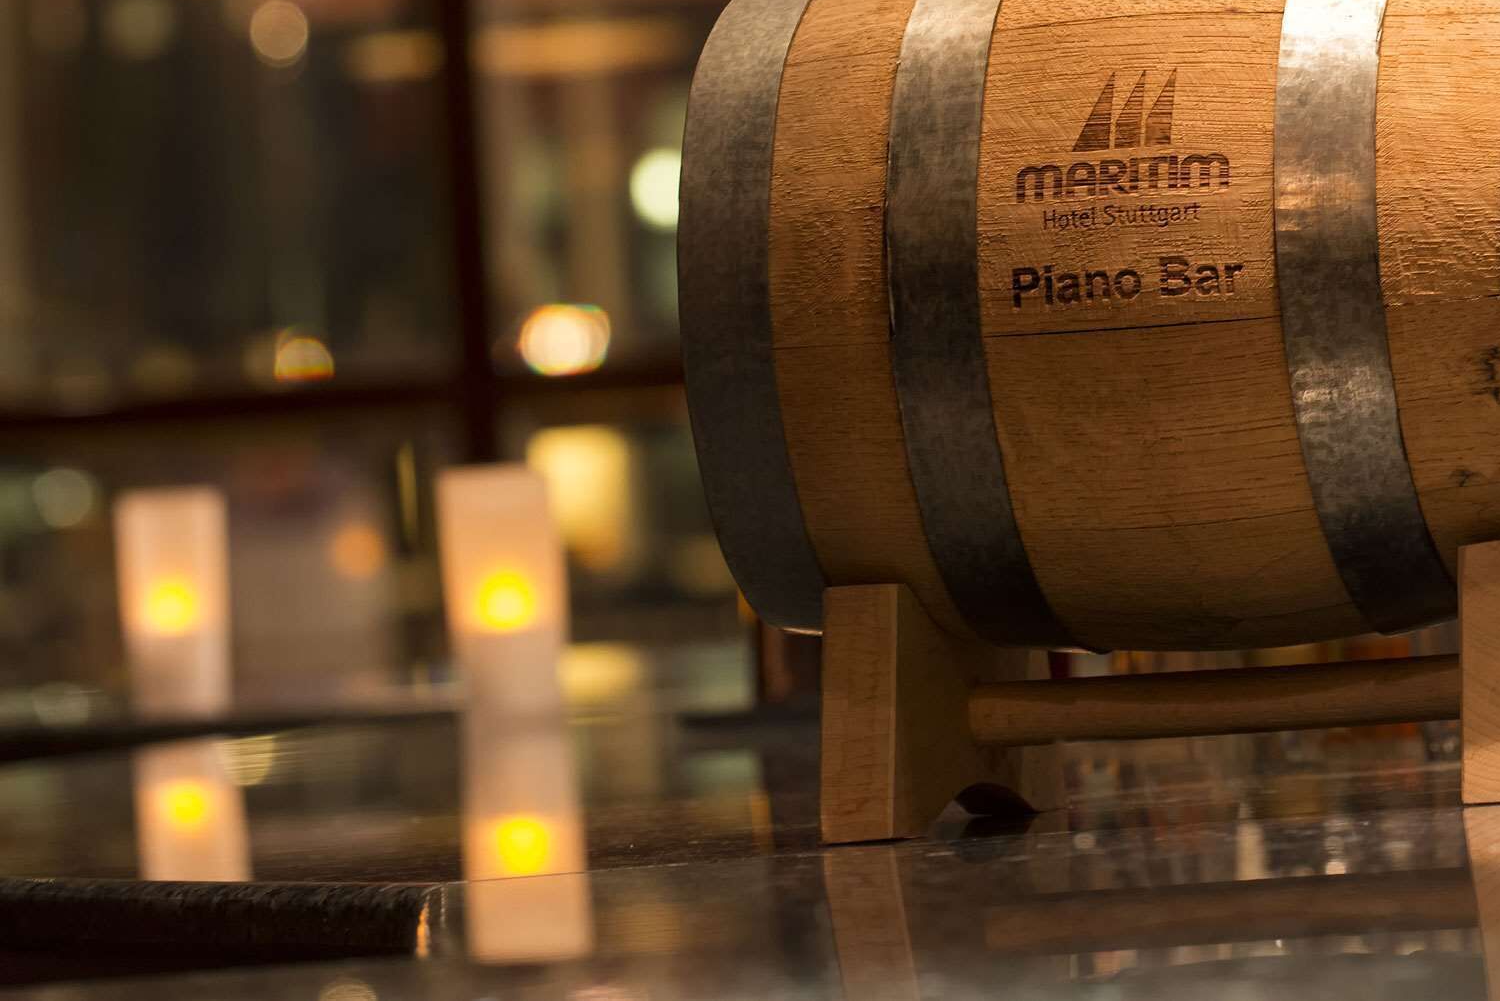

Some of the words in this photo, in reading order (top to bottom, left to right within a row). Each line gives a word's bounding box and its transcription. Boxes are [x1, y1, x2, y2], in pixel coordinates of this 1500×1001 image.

[1016, 152, 1230, 203] MARITIM
[1043, 207, 1096, 230] Hotel
[1103, 202, 1200, 227] Stuttgart
[1011, 264, 1142, 309] Piano
[1159, 255, 1244, 297] Bar
